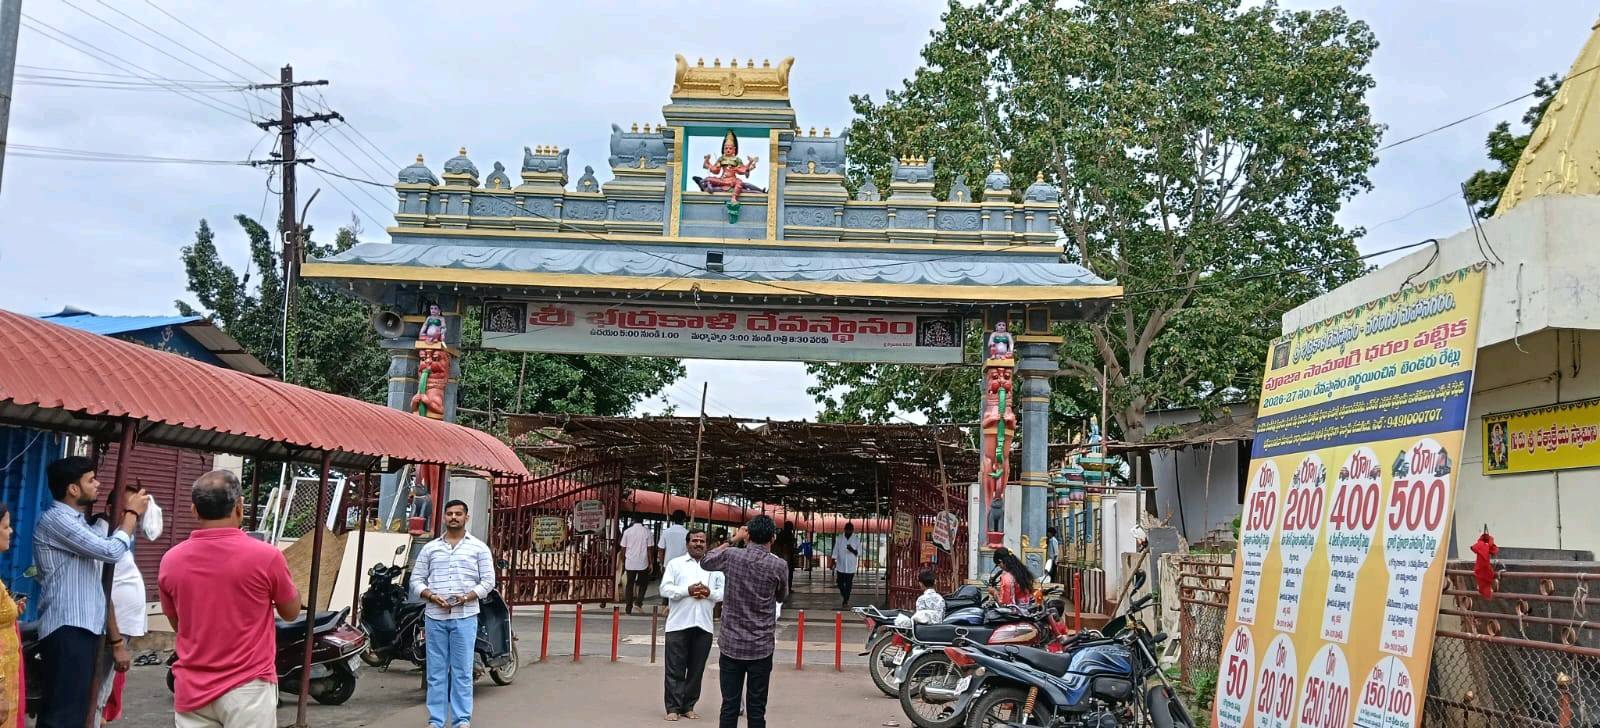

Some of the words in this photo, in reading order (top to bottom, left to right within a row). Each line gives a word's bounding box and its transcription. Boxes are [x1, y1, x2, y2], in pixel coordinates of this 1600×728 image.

[529, 304, 575, 327] శ్రీ
[585, 308, 737, 330] భద్రకాళి
[746, 311, 914, 343] దేవస్థానం
[589, 329, 619, 337] ఉదయం
[619, 330, 639, 339] 5:00
[640, 329, 660, 338] నుండి
[729, 333, 750, 342] 3:00
[751, 333, 772, 343] నుండి
[789, 335, 808, 343] 8:30
[809, 335, 829, 344] వరకు
[1265, 370, 1300, 392] పూజా
[1364, 338, 1409, 362] ధరల
[1413, 318, 1469, 350] పట్టిక
[1263, 391, 1297, 408] 2026-27
[1400, 356, 1436, 375] టెండరు
[1245, 490, 1276, 531] 150
[1283, 487, 1323, 531] 200
[1329, 484, 1380, 531] 400
[1388, 479, 1445, 532] 500
[1226, 655, 1248, 699] 50
[1258, 668, 1276, 714] 20
[1275, 673, 1294, 721] 30
[1364, 681, 1385, 709] 150
[1301, 676, 1325, 728] 250
[1324, 682, 1349, 728] 300
[1387, 688, 1412, 716] 100
